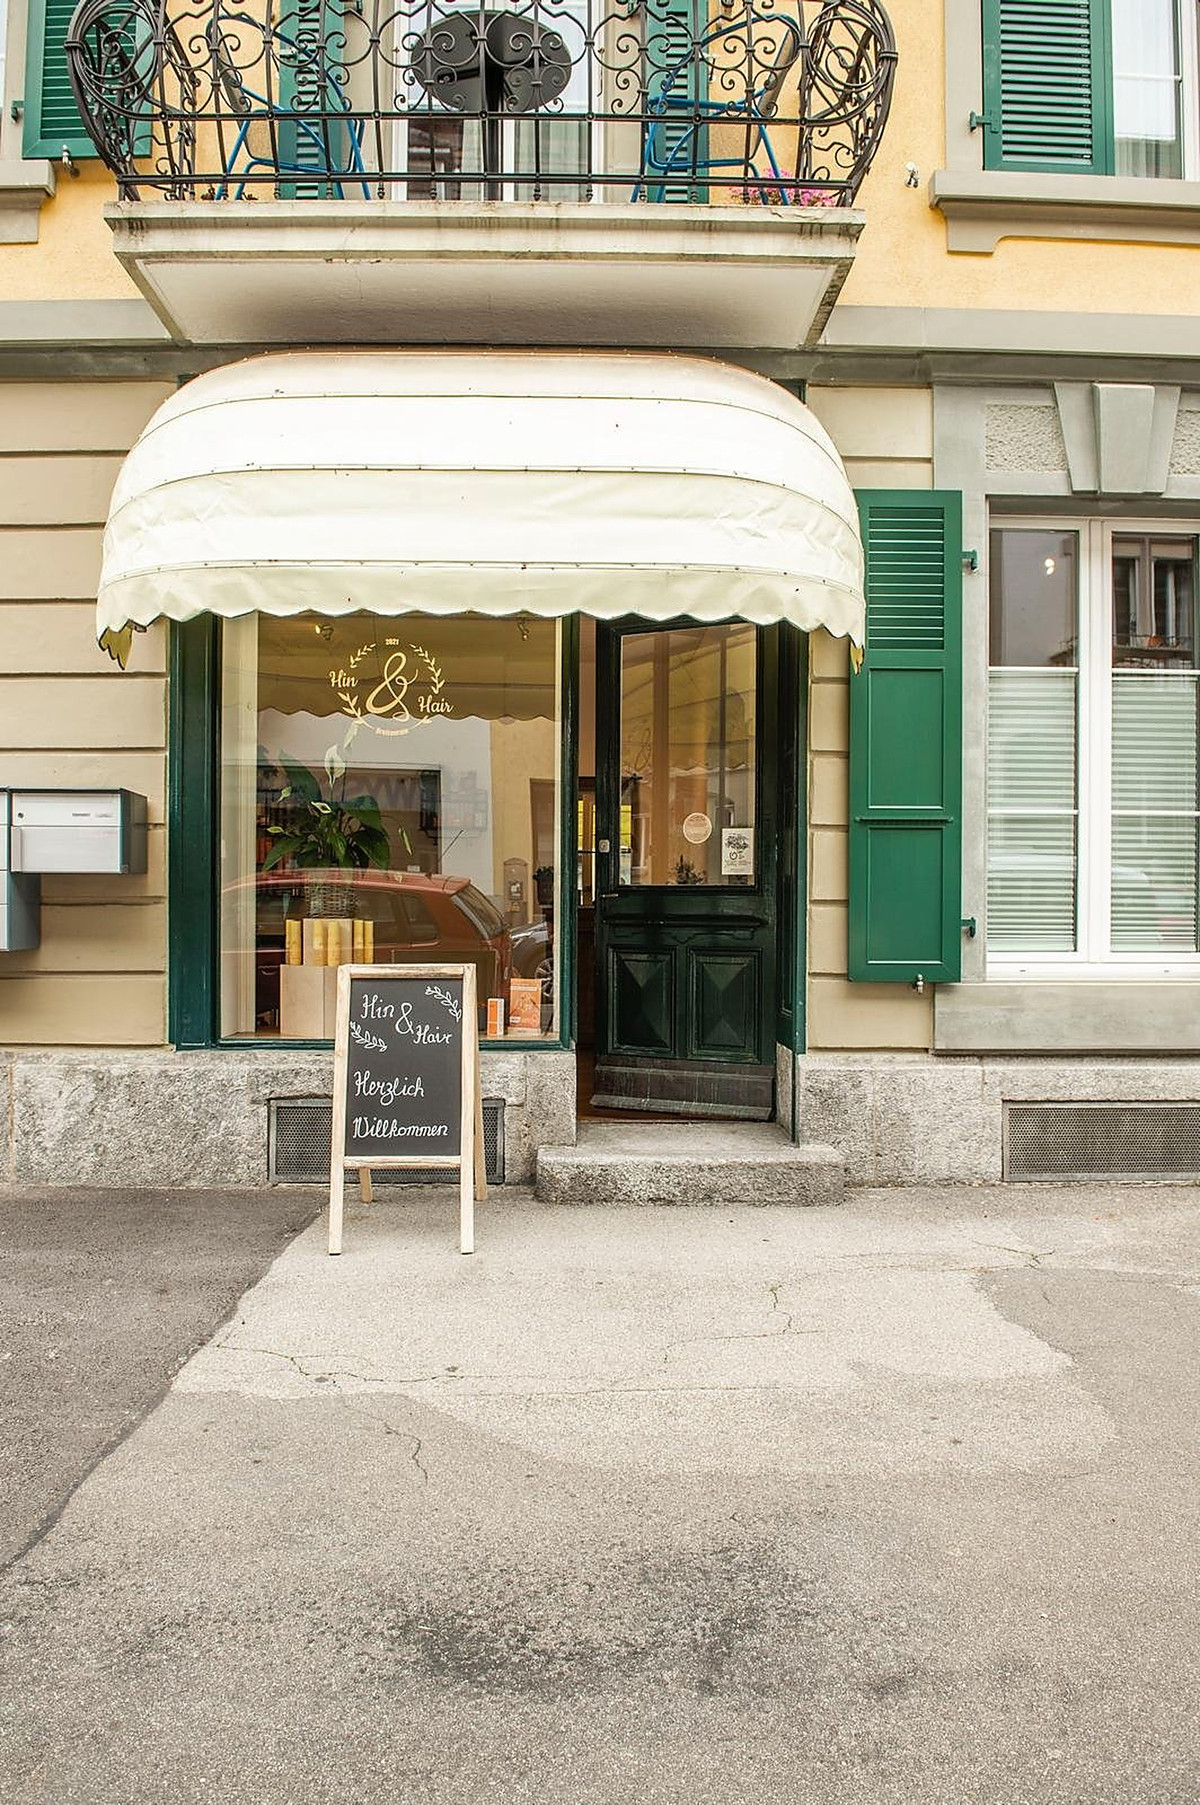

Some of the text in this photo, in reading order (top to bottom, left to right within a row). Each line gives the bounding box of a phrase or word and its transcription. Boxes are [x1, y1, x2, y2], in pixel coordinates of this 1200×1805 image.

[329, 651, 454, 722] Hin & Hair
[360, 994, 452, 1045] Hin & Hair
[353, 1070, 425, 1106] Herzlich
[352, 1116, 449, 1139] Willkommen
